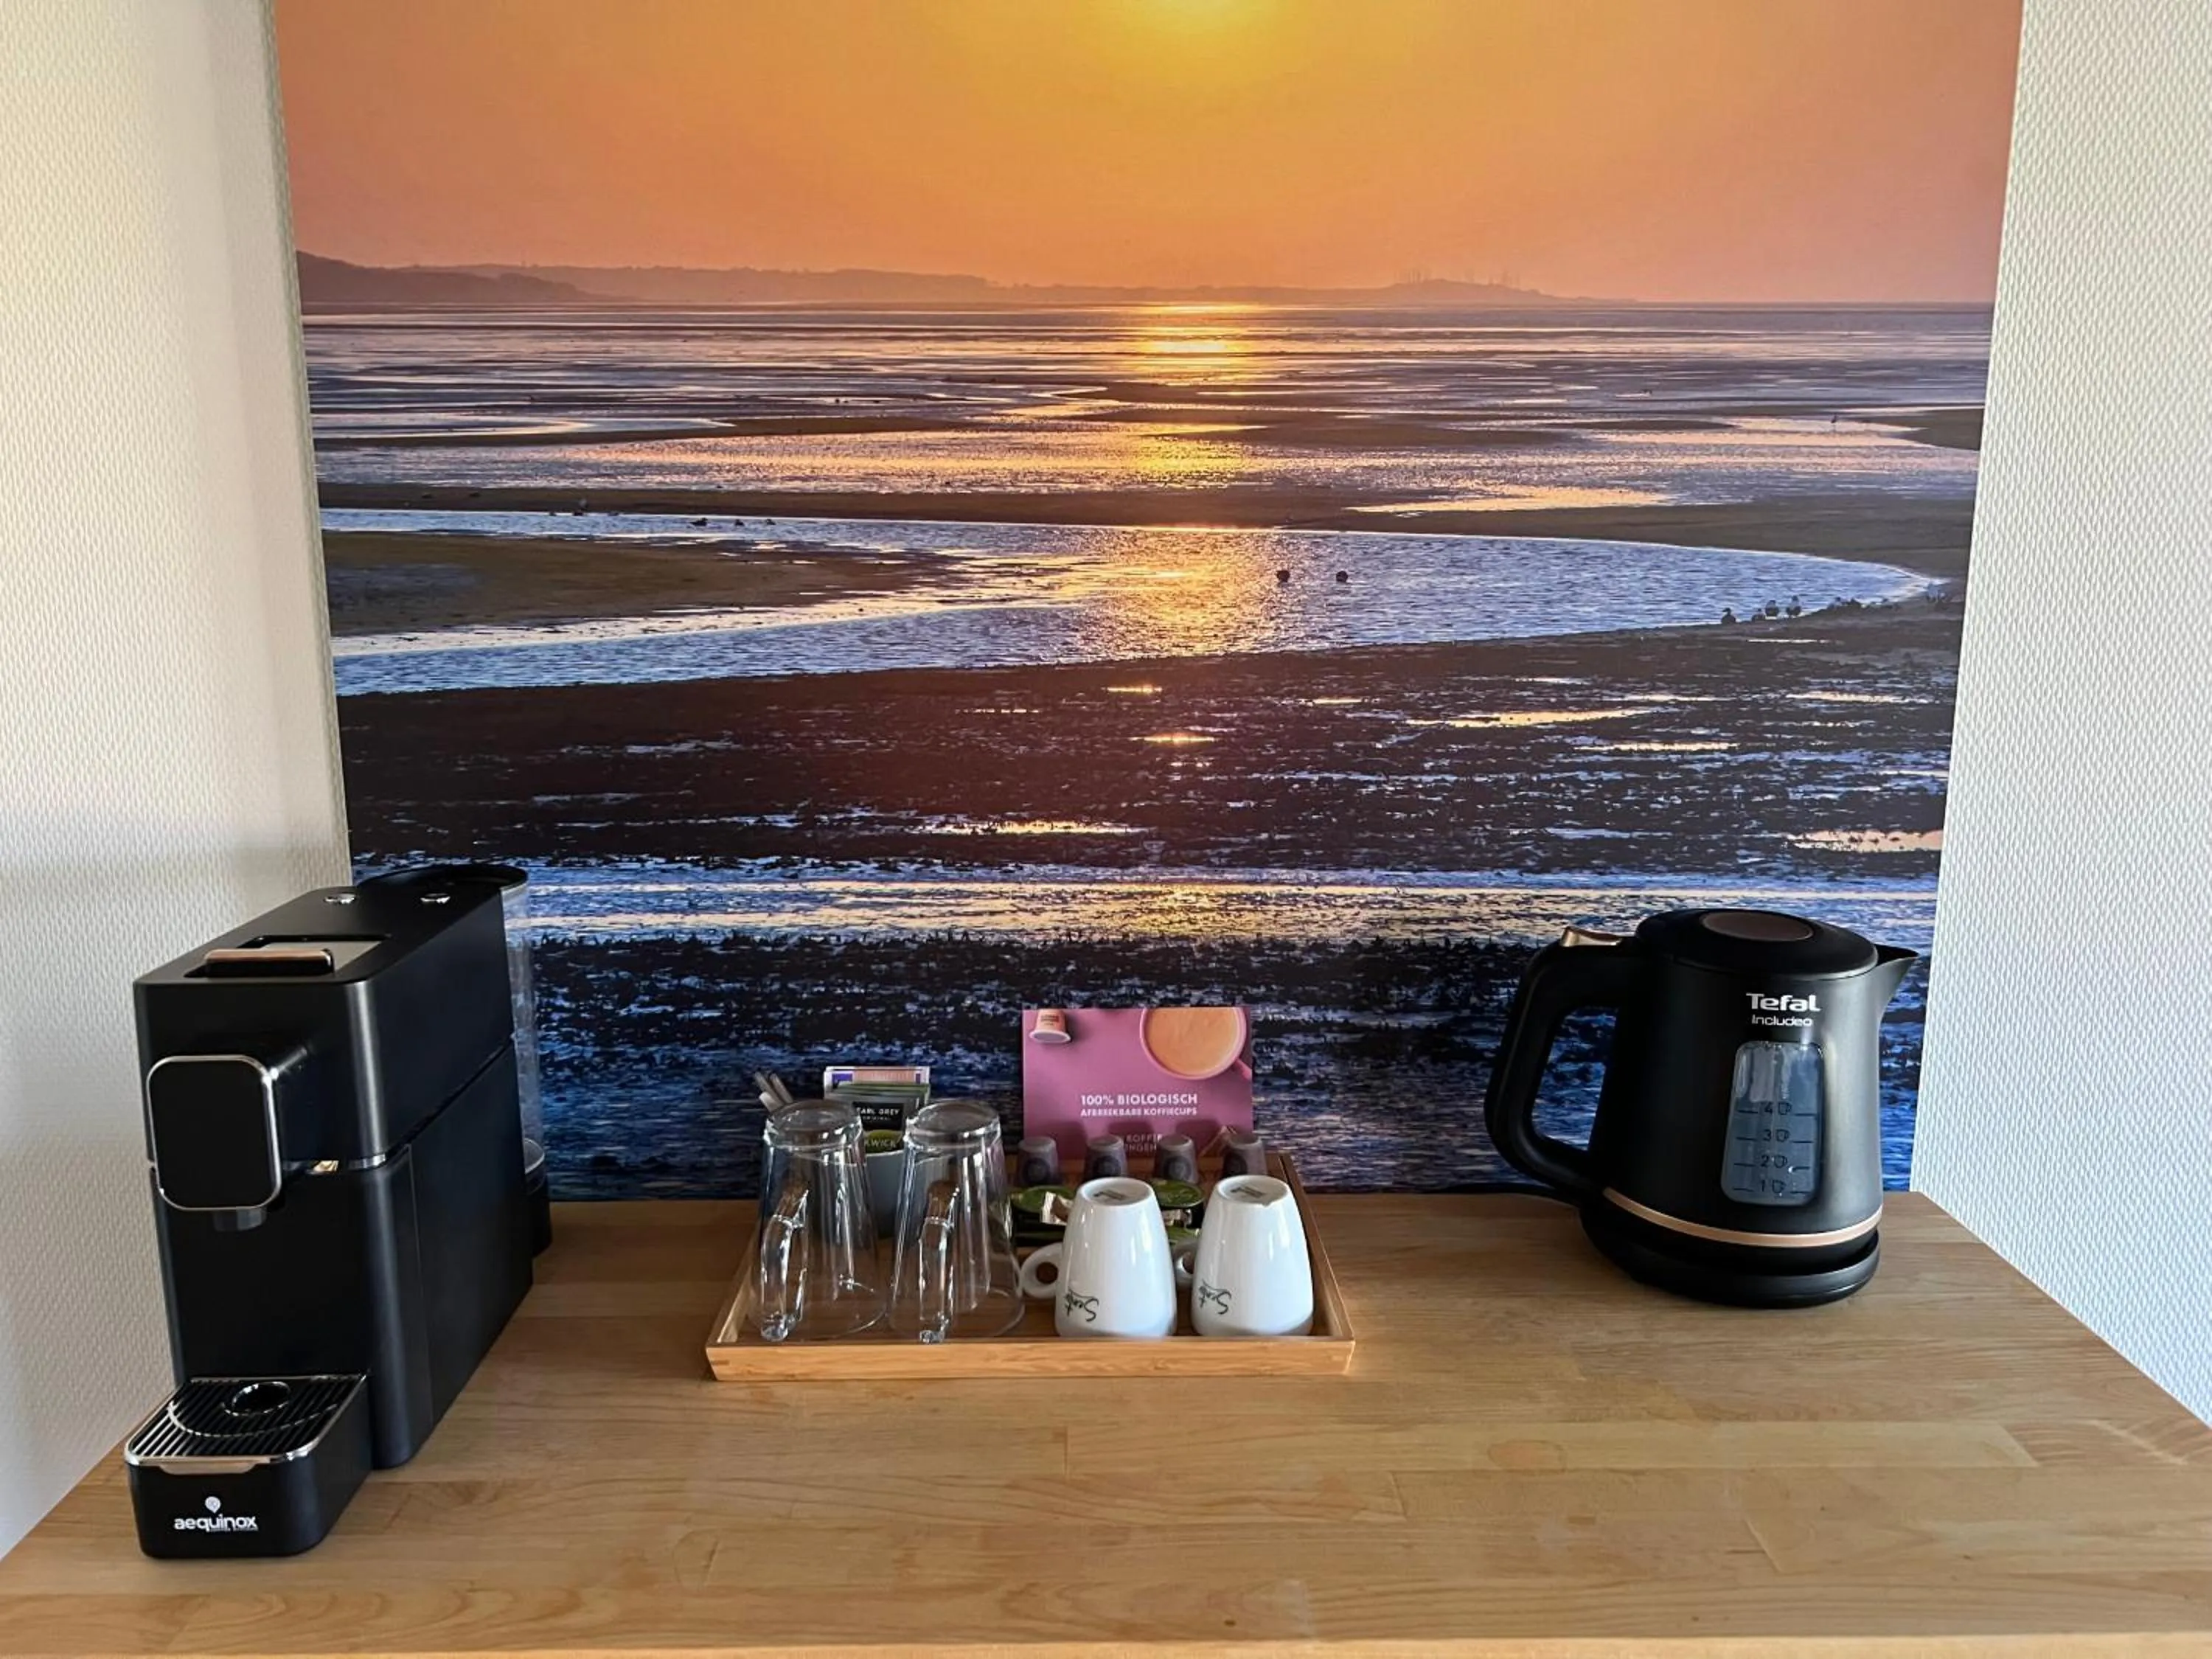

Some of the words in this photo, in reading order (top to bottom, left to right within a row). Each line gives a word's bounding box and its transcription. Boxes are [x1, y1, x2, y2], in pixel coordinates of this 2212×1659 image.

[1746, 992, 1821, 1012] Tefal
[1751, 1015, 1813, 1027] Includeo
[1080, 1094, 1114, 1105] 100%
[1117, 1093, 1198, 1105] BIOLOGISCH
[1144, 1107, 1197, 1116] KOFFIECUPS
[1762, 1129, 1773, 1141] 3
[1760, 1155, 1770, 1167] 2
[174, 1514, 257, 1532] aequinox
